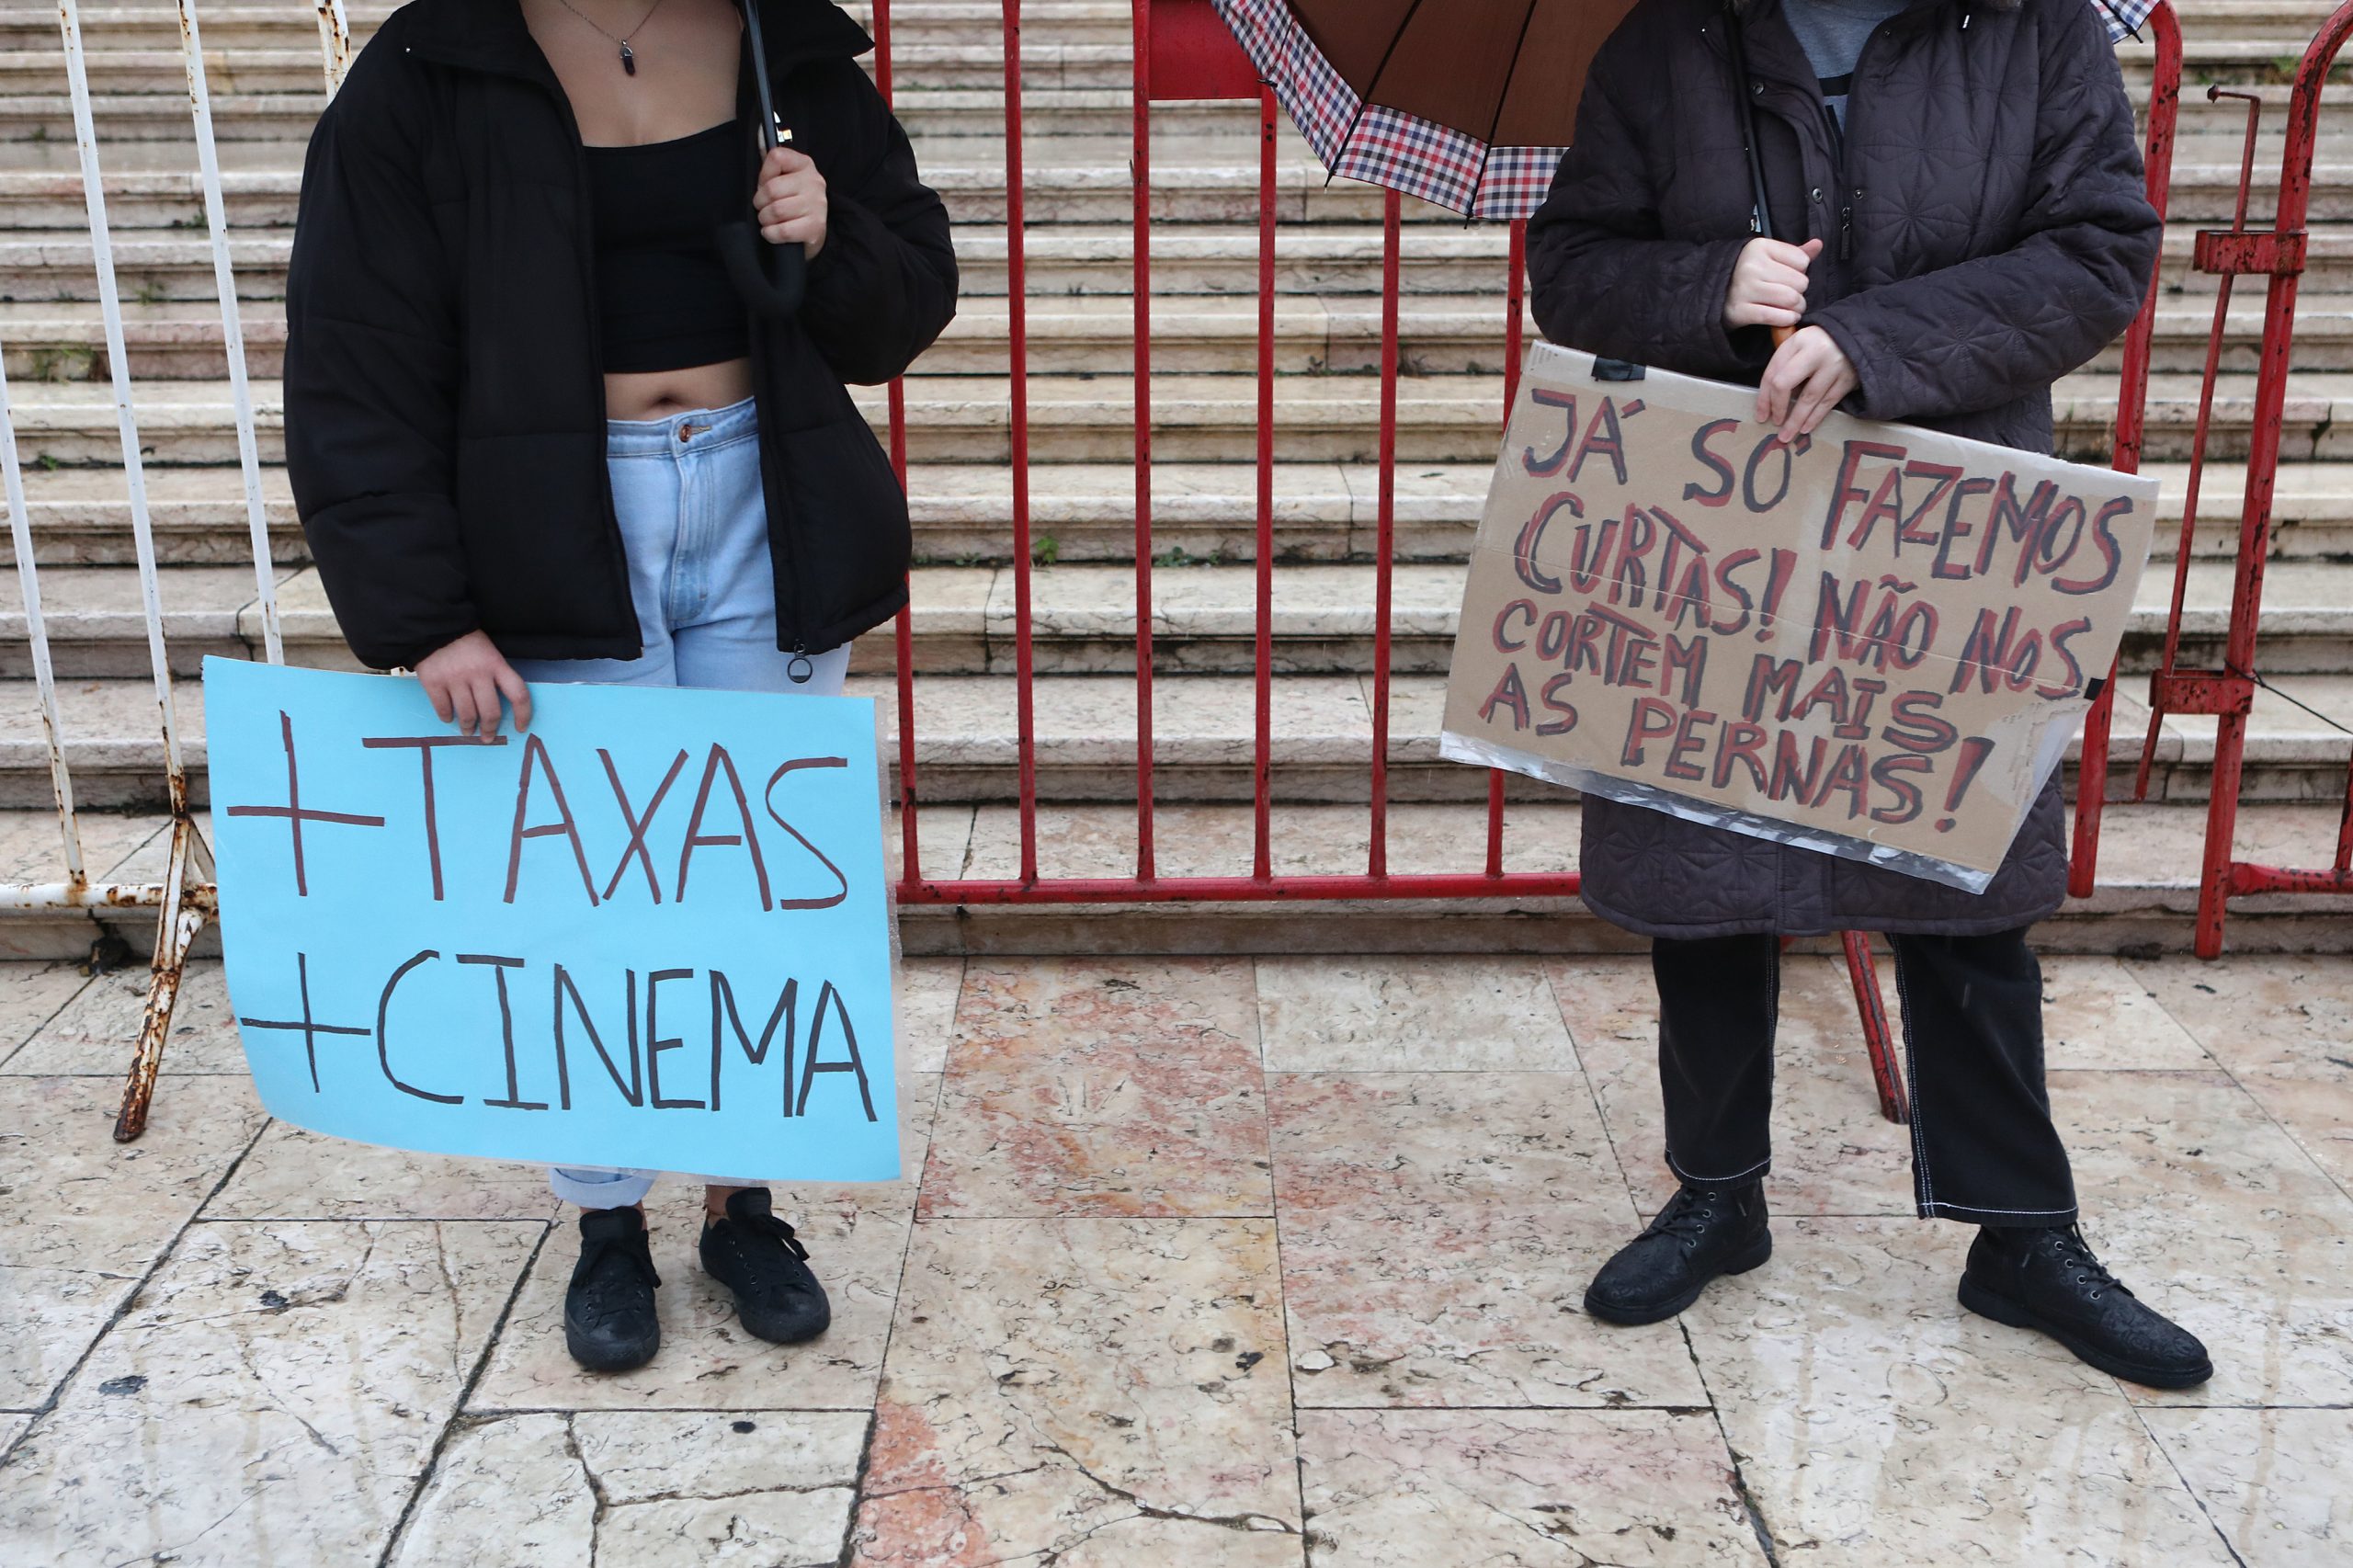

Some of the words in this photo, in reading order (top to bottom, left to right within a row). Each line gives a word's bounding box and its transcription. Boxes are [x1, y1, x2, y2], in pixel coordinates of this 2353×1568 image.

[1522, 388, 1646, 483] JÁ
[1683, 418, 1811, 513] SÓ
[1821, 439, 2132, 595] FAZEMOS
[1493, 598, 1711, 708] CORTEM
[1742, 653, 1959, 754] MAIS
[1514, 491, 1797, 642] CURTAS!
[1808, 571, 1938, 671] NÃO
[1951, 605, 2092, 699] NOS
[1479, 663, 1579, 735] AS
[1620, 696, 1994, 833] PERNAS!
